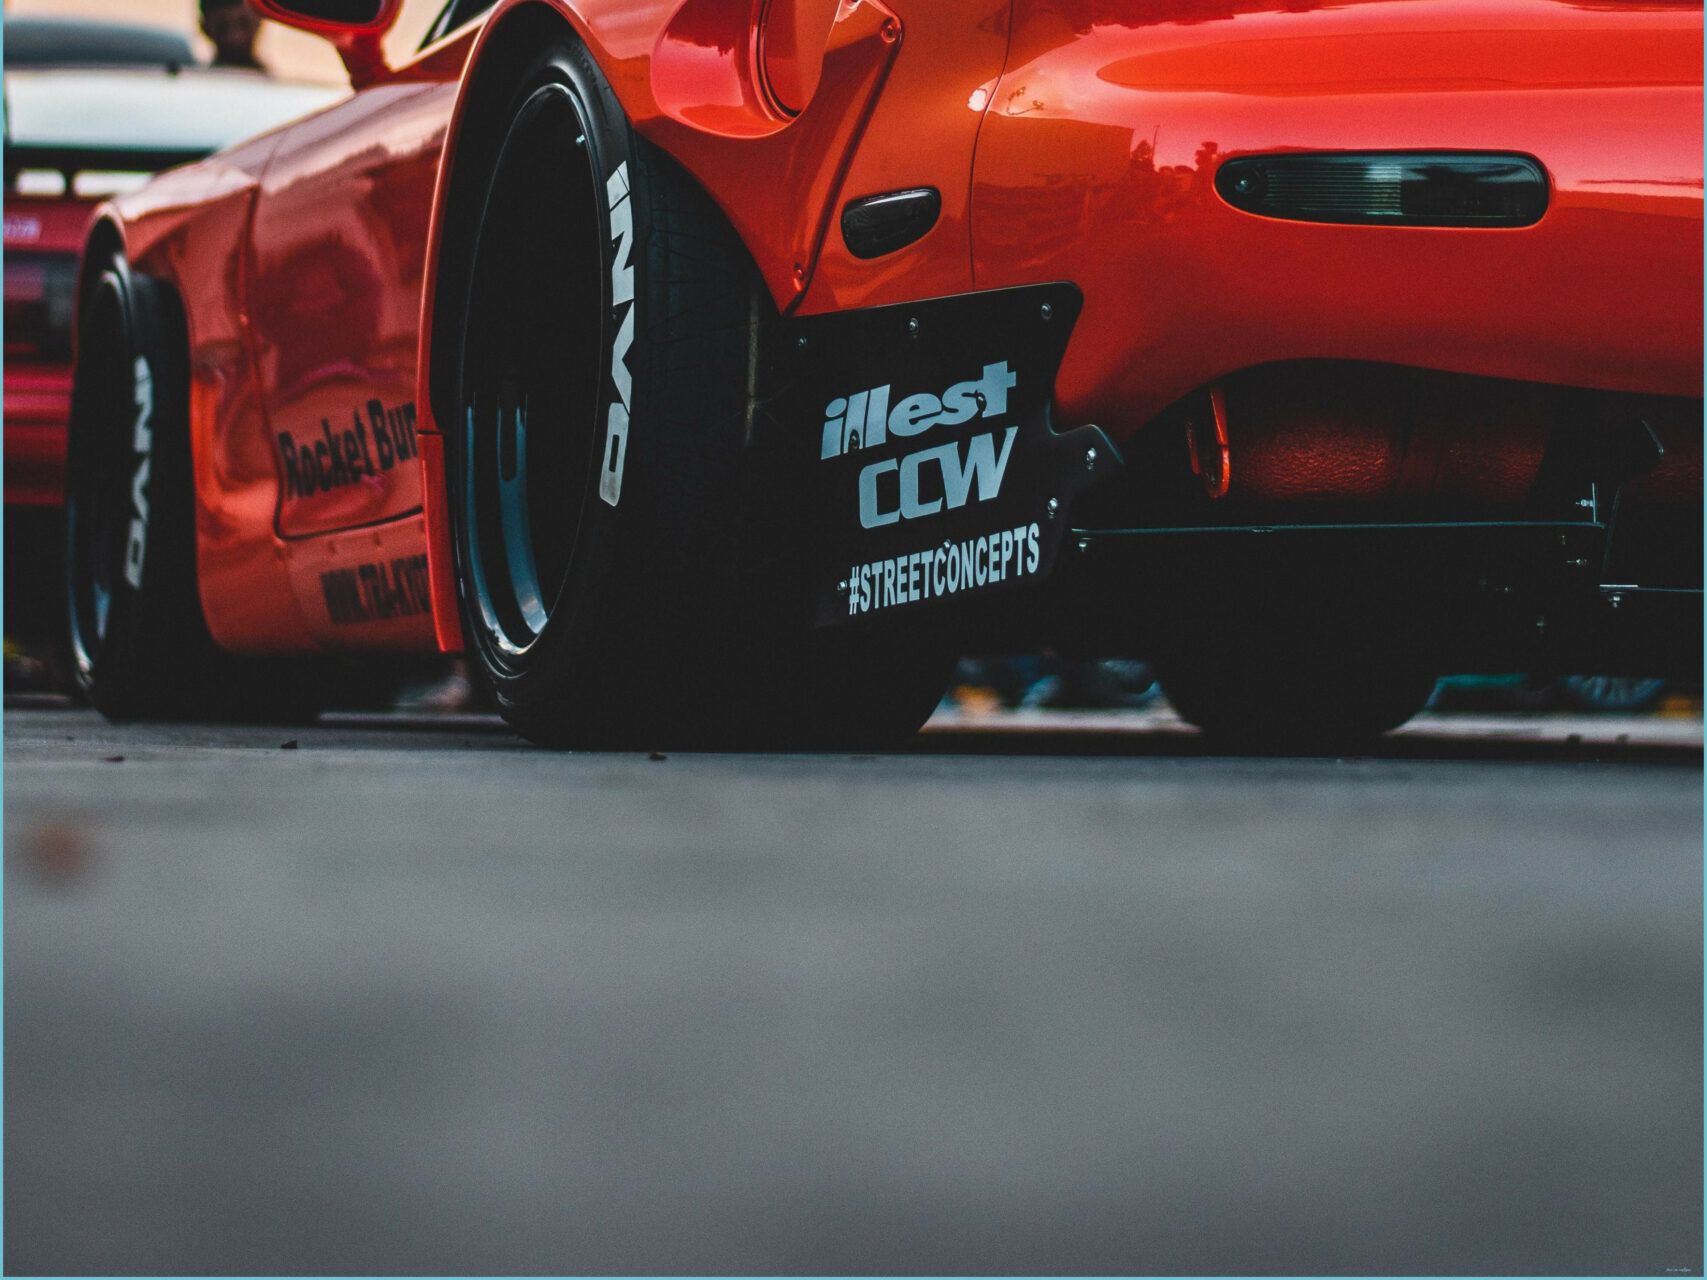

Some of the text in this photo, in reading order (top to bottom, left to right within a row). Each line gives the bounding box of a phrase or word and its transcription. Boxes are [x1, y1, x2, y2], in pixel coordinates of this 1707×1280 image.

[600, 160, 635, 507] INVO
[277, 406, 376, 501] Rocket
[820, 360, 1017, 460] illest
[858, 425, 1019, 530] CCW
[849, 522, 1040, 616] #STREETCONCEPTS
